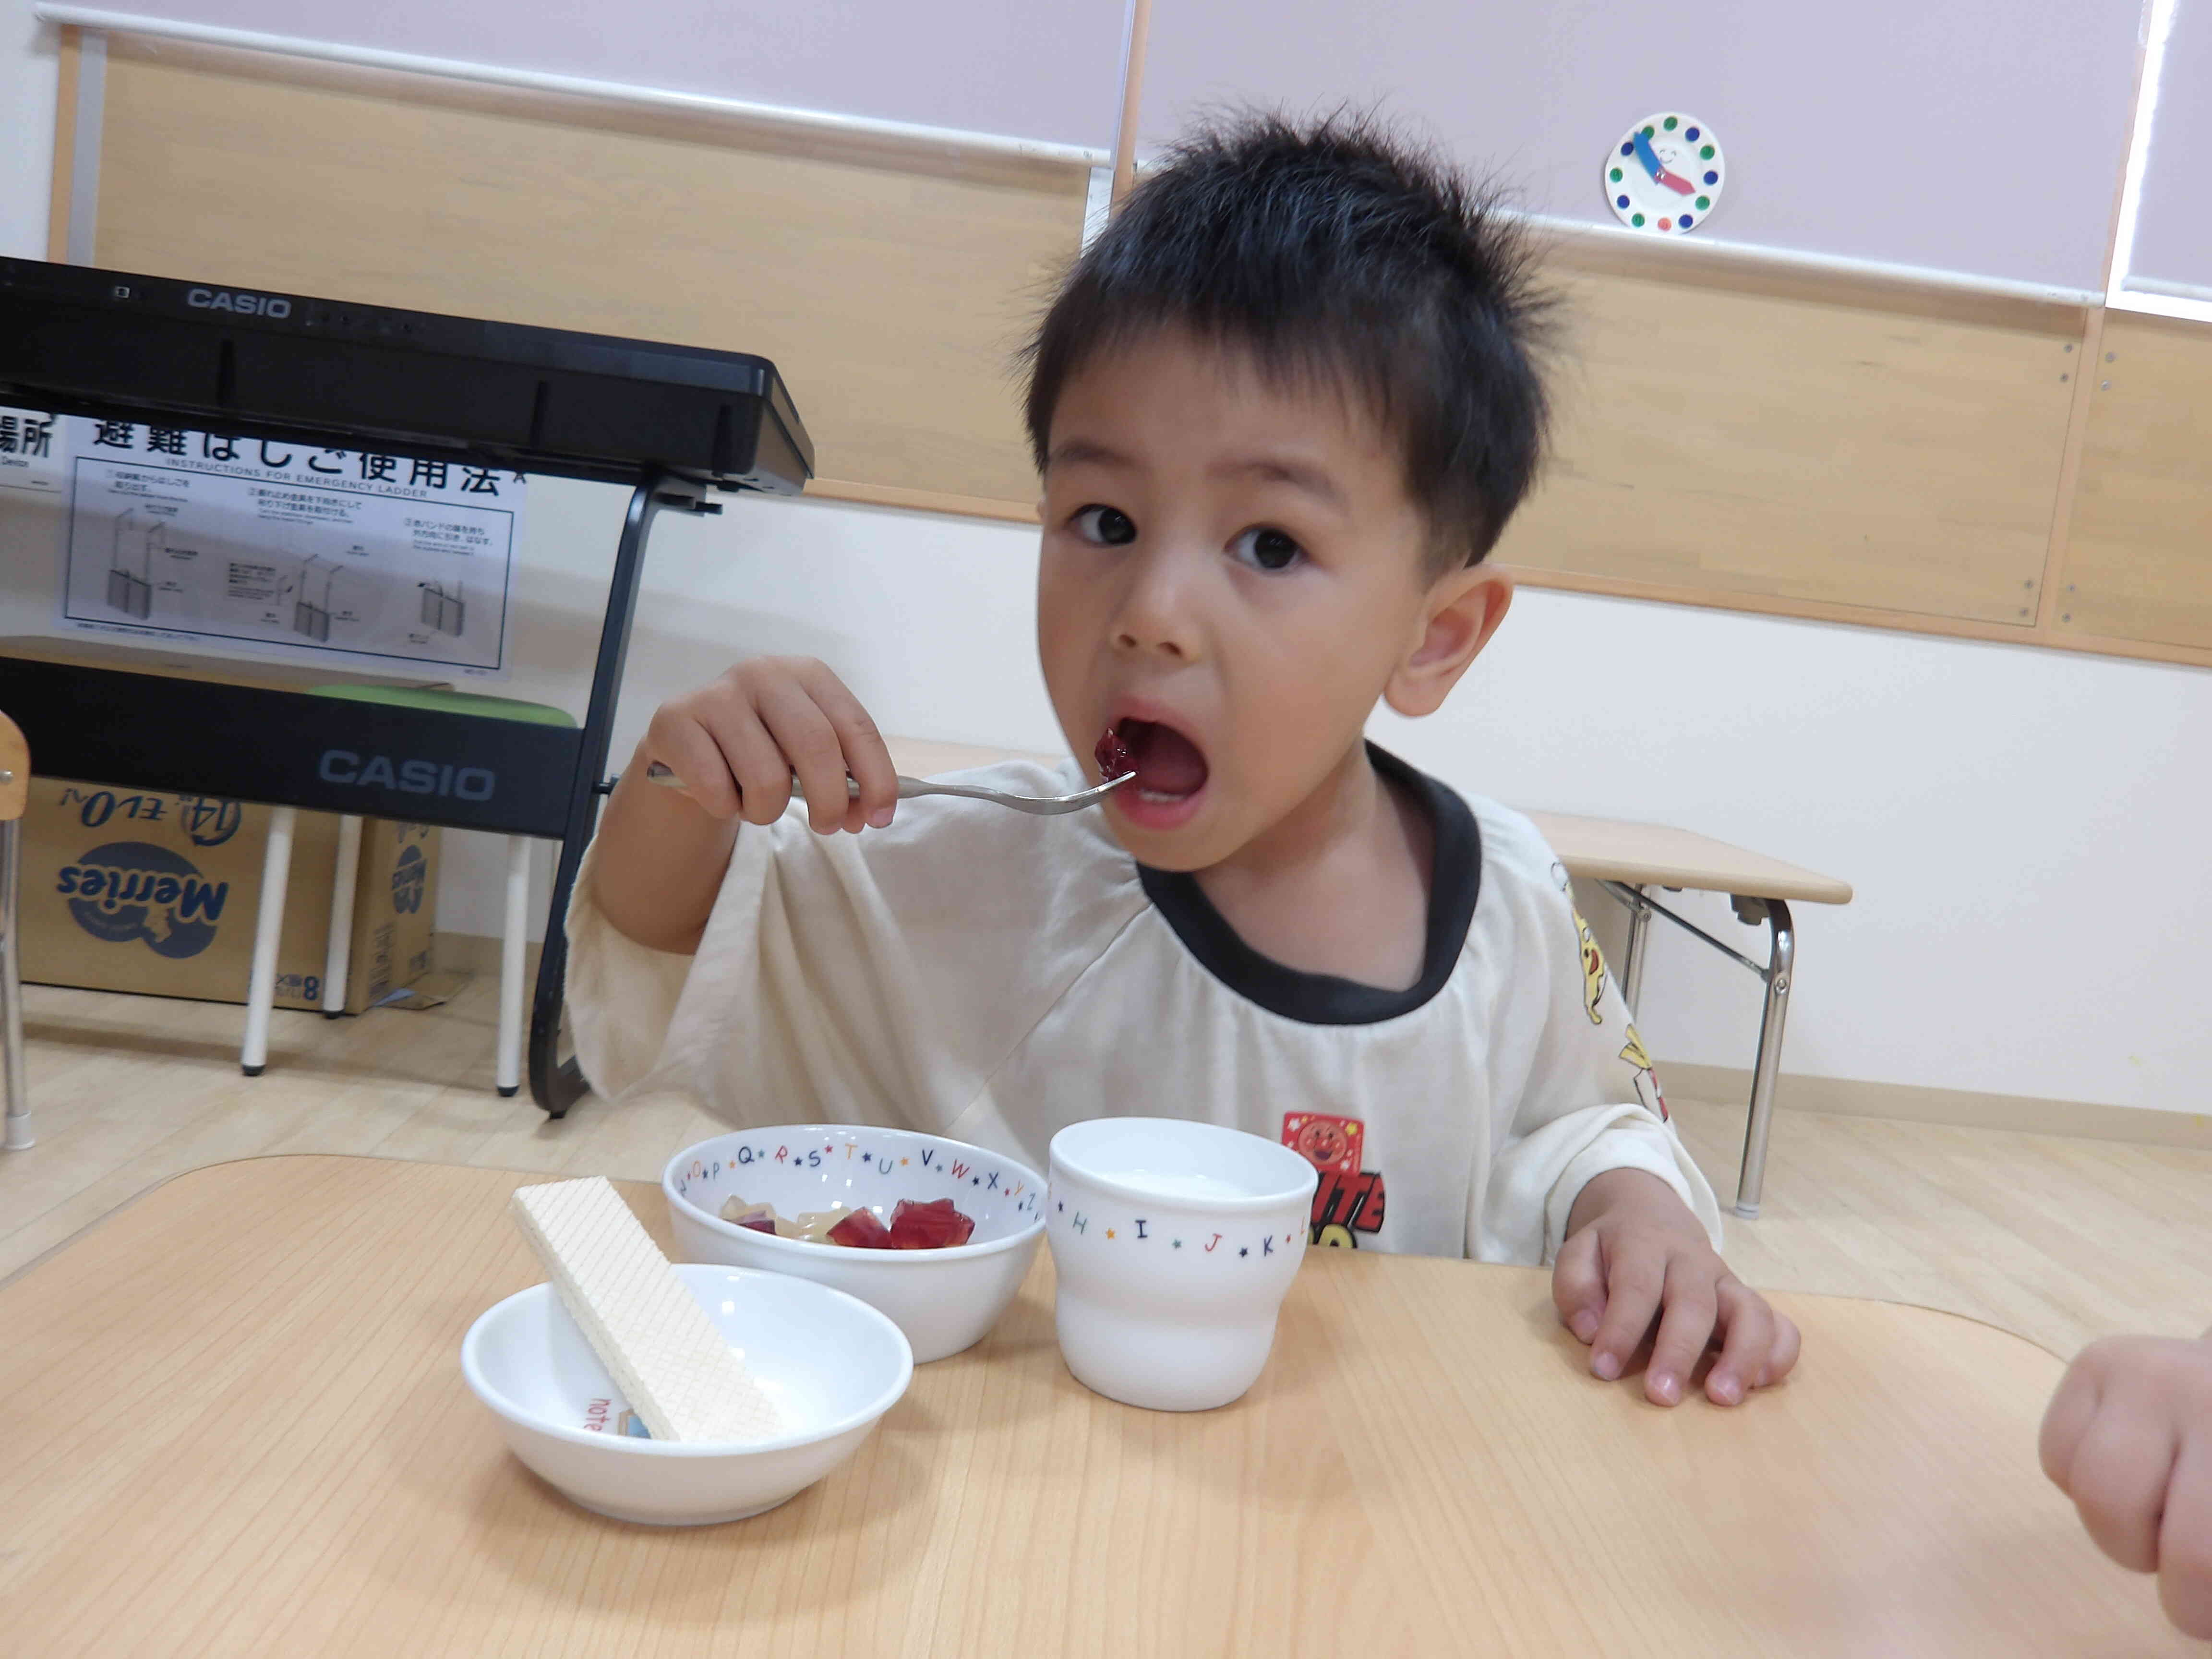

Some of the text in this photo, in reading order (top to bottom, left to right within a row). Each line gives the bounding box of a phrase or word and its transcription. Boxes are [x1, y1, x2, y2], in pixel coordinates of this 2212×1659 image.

[188, 289, 292, 319] CASIO
[93, 420, 501, 496] 避難はしご使用法
[166, 458, 427, 498] INSTRUCTIONS FOR EMERGENCY LADDER
[319, 749, 495, 801] CASIO
[56, 866, 229, 921] Merries
[304, 976, 318, 1000] 8
[713, 1162, 720, 1180] P
[738, 1146, 755, 1164] Q
[775, 1145, 788, 1164] R
[808, 1150, 821, 1167] S
[844, 1143, 858, 1160] T
[878, 1157, 893, 1175] U
[922, 1149, 934, 1166] V
[951, 1158, 970, 1179] W
[987, 1171, 999, 1190] X
[1014, 1179, 1025, 1196] Y
[1027, 1192, 1036, 1210] Z
[1073, 1212, 1087, 1235] H
[1135, 1219, 1148, 1238] I
[1205, 1234, 1222, 1252] J
[1263, 1235, 1273, 1256] K
